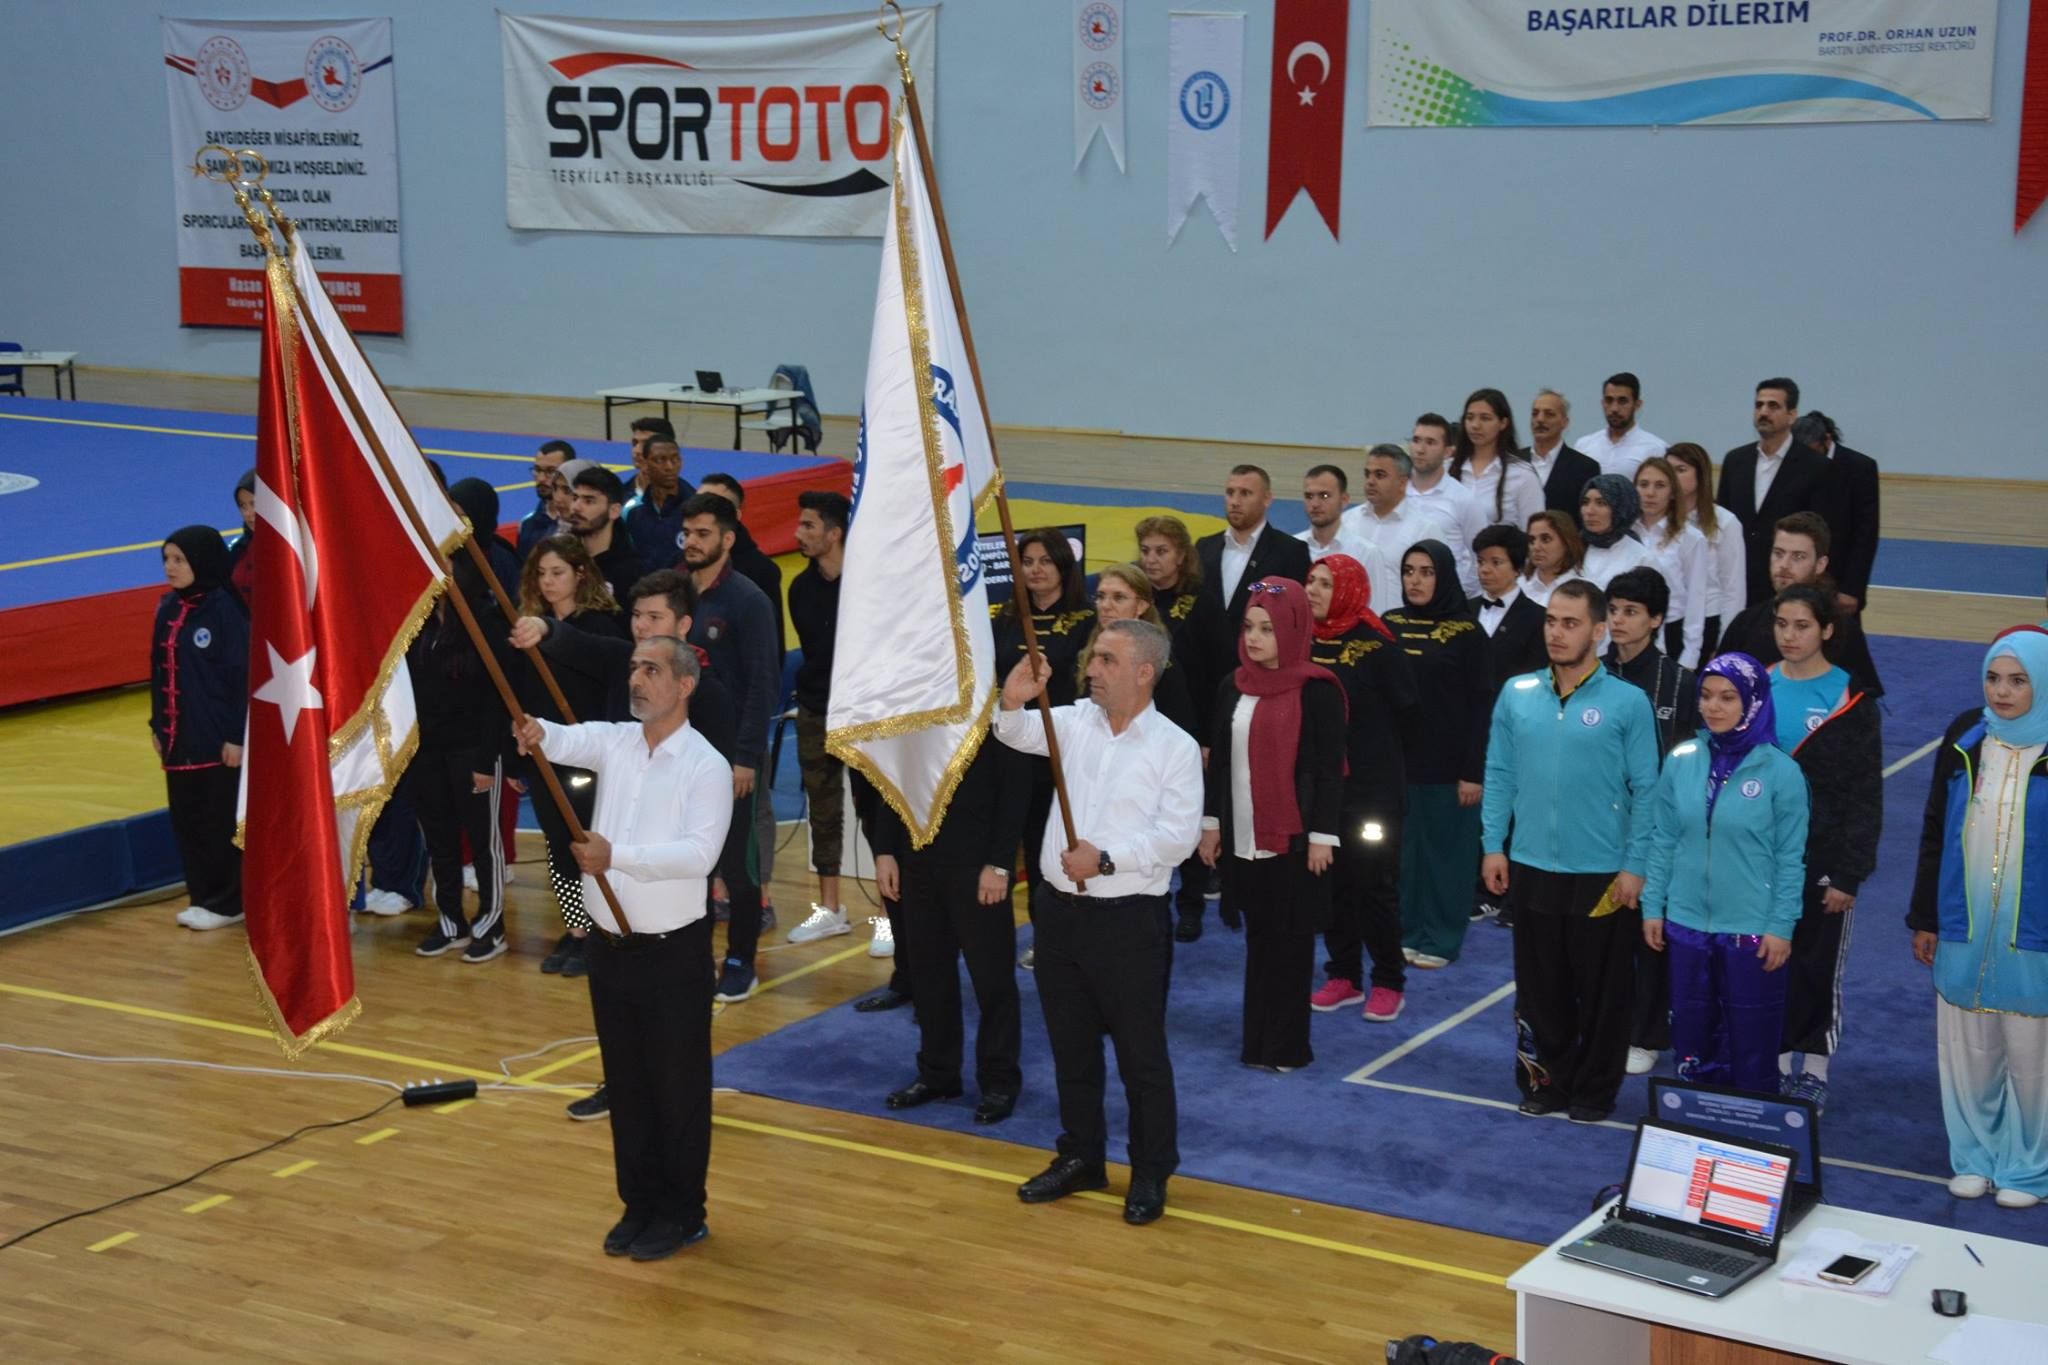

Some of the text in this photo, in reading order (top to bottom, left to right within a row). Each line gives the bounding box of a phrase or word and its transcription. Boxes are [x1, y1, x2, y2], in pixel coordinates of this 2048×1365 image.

[1527, 6, 1677, 35] BAŞARILAR
[1886, 28, 1933, 40] ORHAN
[1938, 26, 1977, 38] UZUN
[551, 168, 714, 188] TEŞKİLAT BAŞKANLIĞI
[302, 190, 332, 203] OLAN
